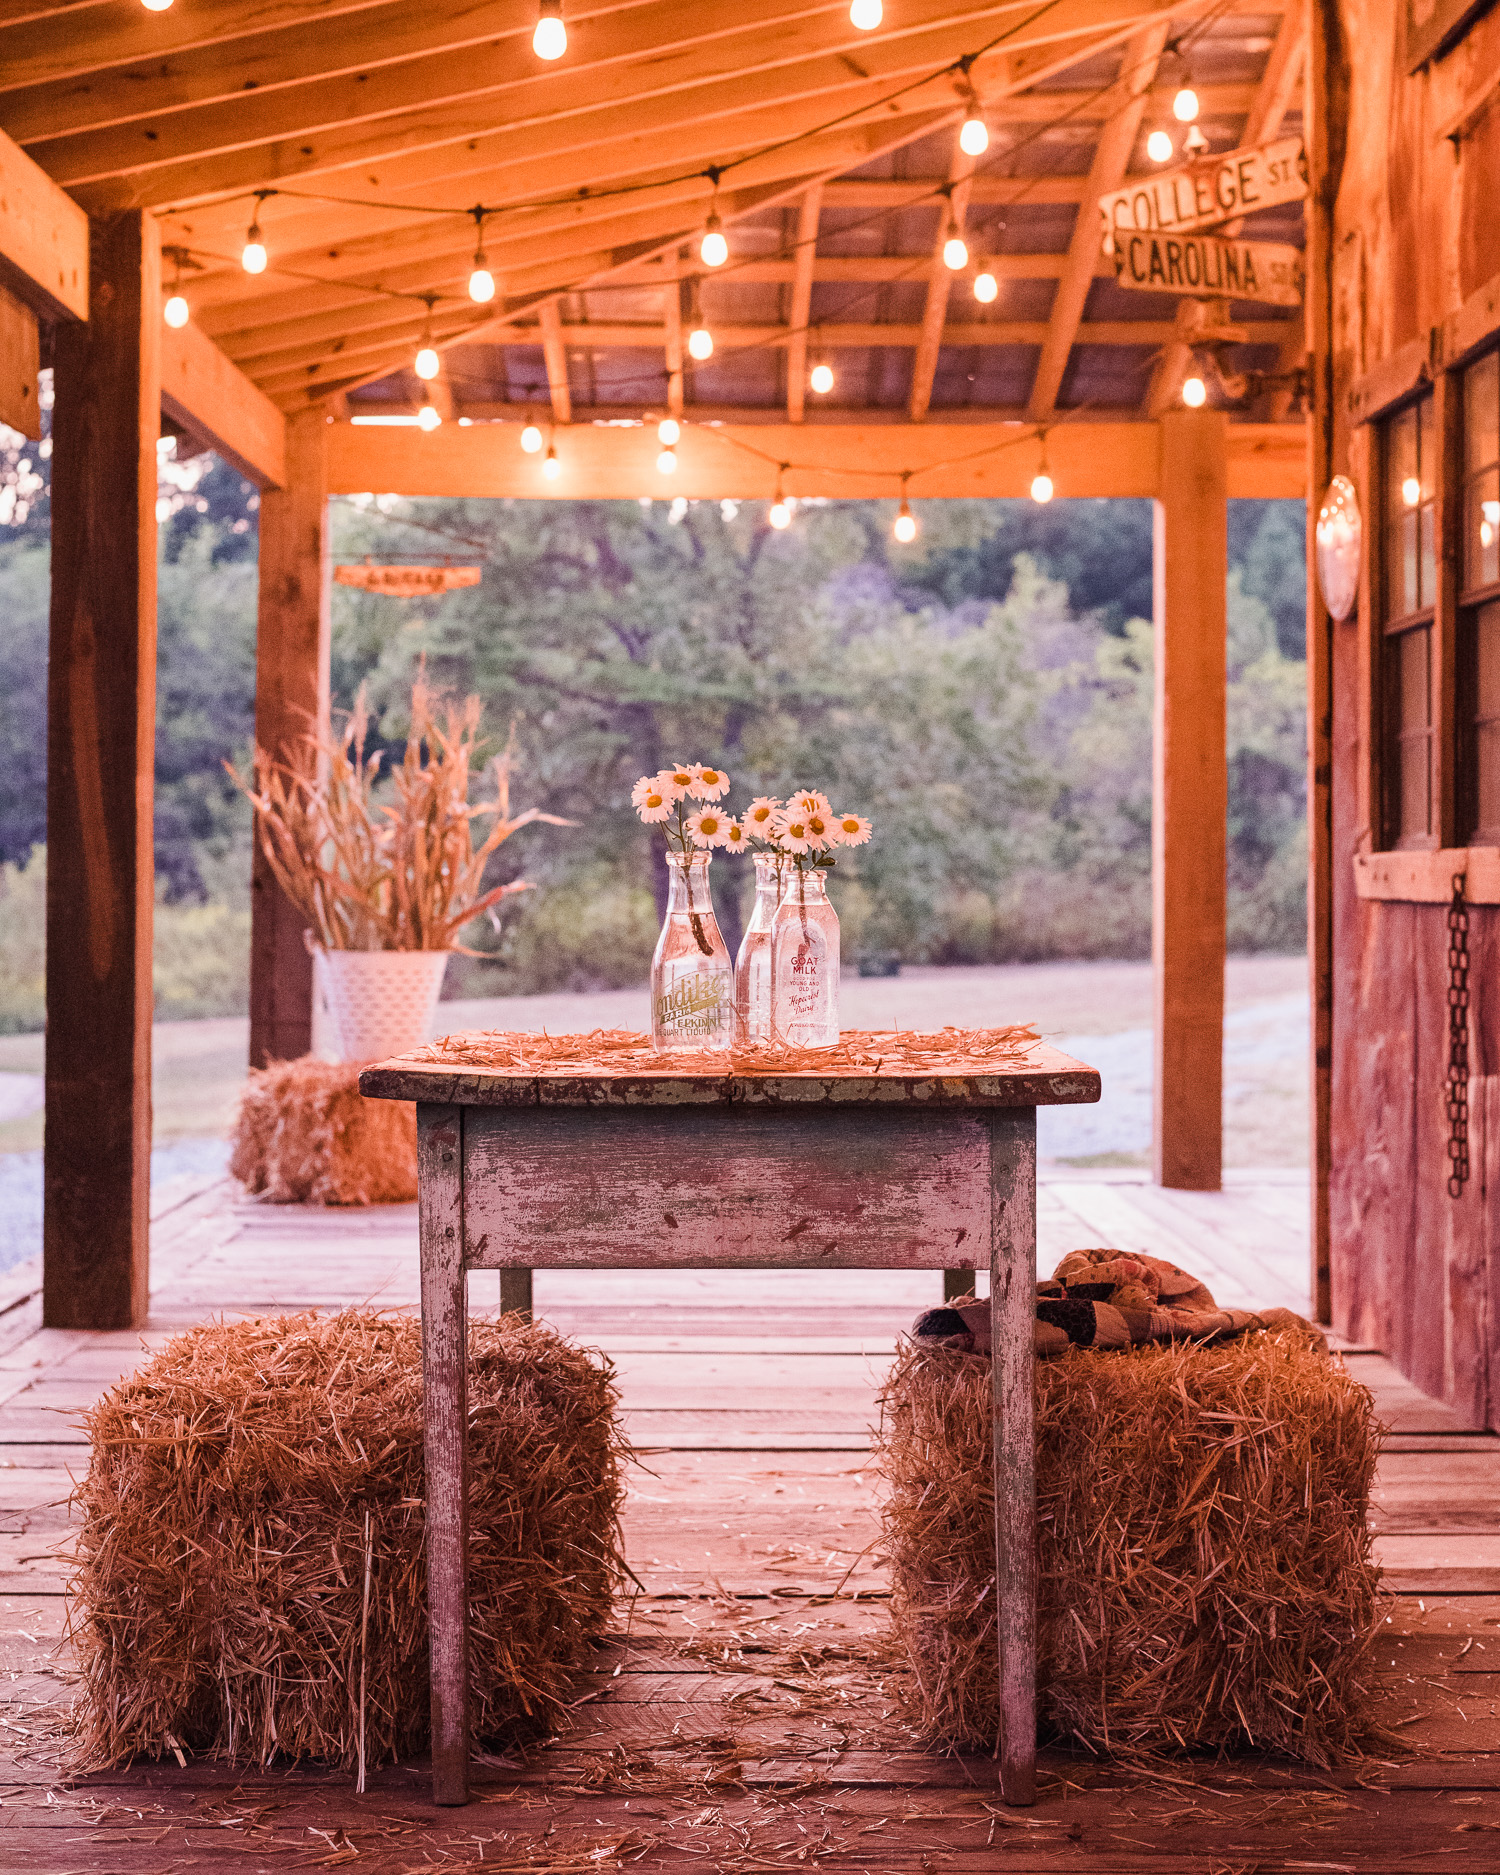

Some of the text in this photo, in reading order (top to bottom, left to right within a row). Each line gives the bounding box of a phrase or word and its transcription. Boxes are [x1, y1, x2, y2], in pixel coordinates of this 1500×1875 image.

[1113, 157, 1261, 231] COLLEGE
[1128, 236, 1260, 293] CAROLINA
[790, 956, 819, 966] GOAT
[792, 966, 817, 975] MILK
[662, 1028, 684, 1037] QUART
[686, 1027, 711, 1036] LIQUID
